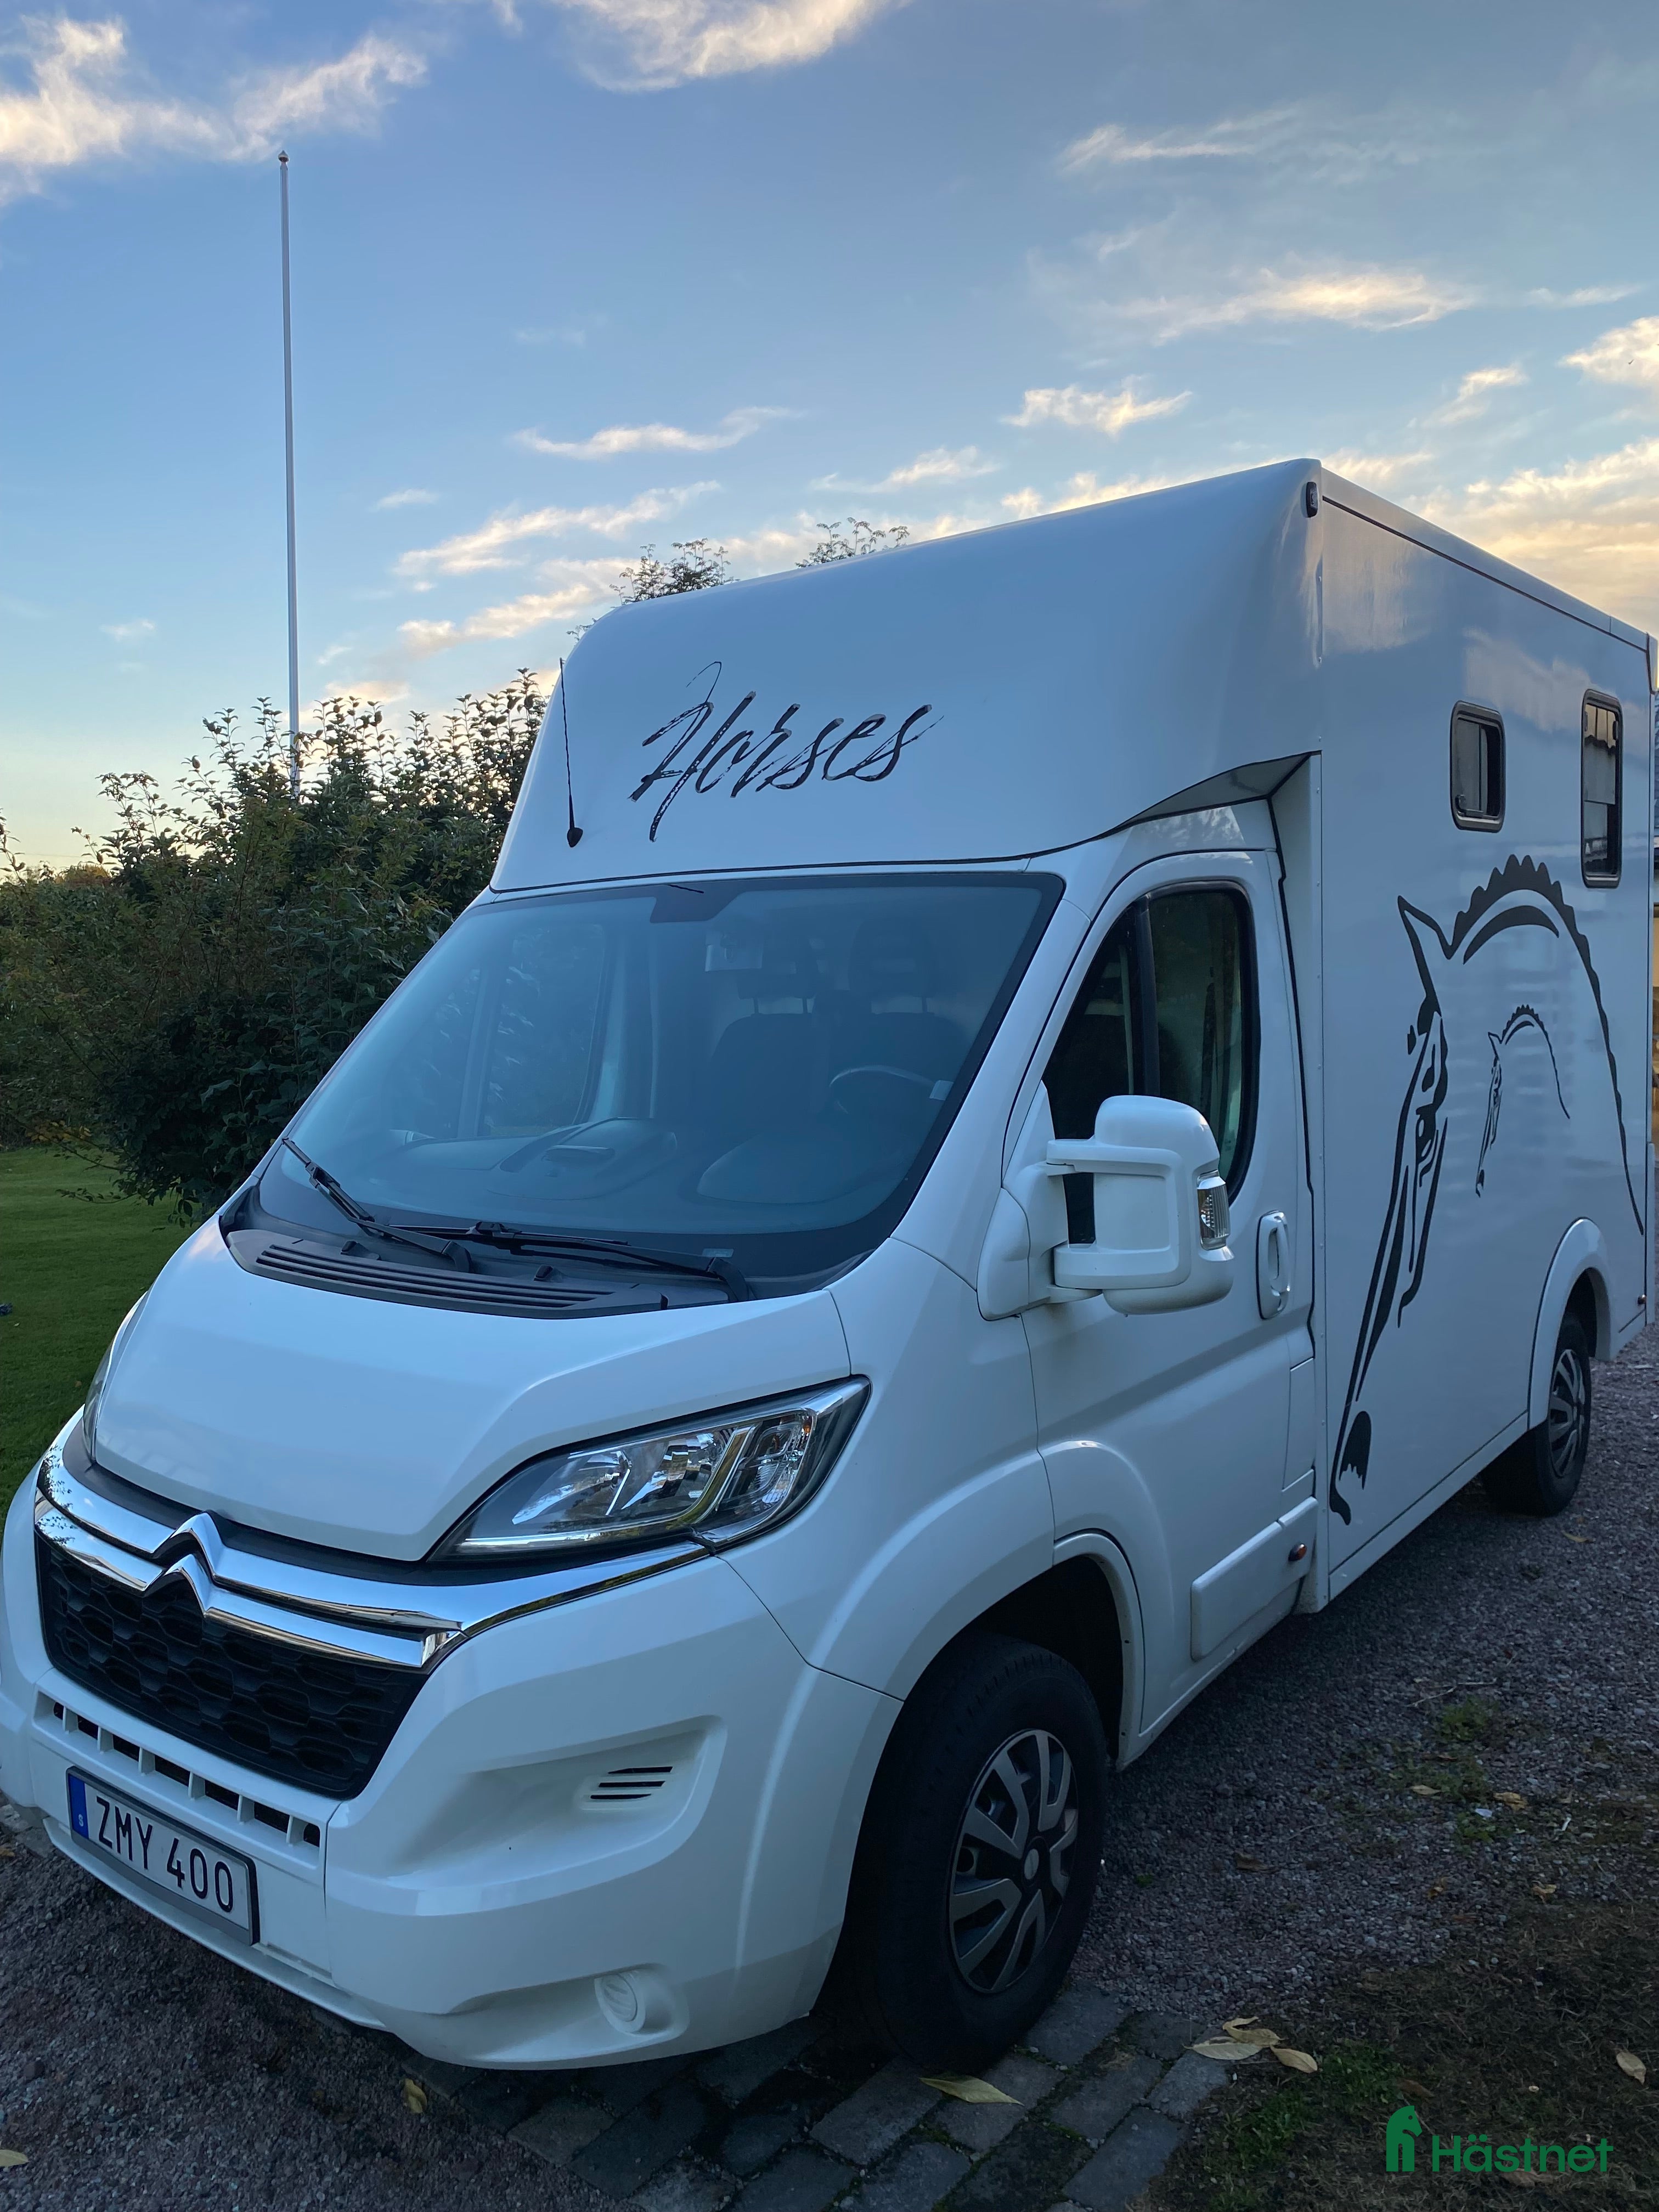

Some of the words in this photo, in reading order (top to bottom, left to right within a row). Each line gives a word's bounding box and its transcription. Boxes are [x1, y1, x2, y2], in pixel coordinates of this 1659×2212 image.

[628, 662, 944, 842] Horses
[97, 1796, 153, 1870] ZMY
[167, 1838, 233, 1912] 400
